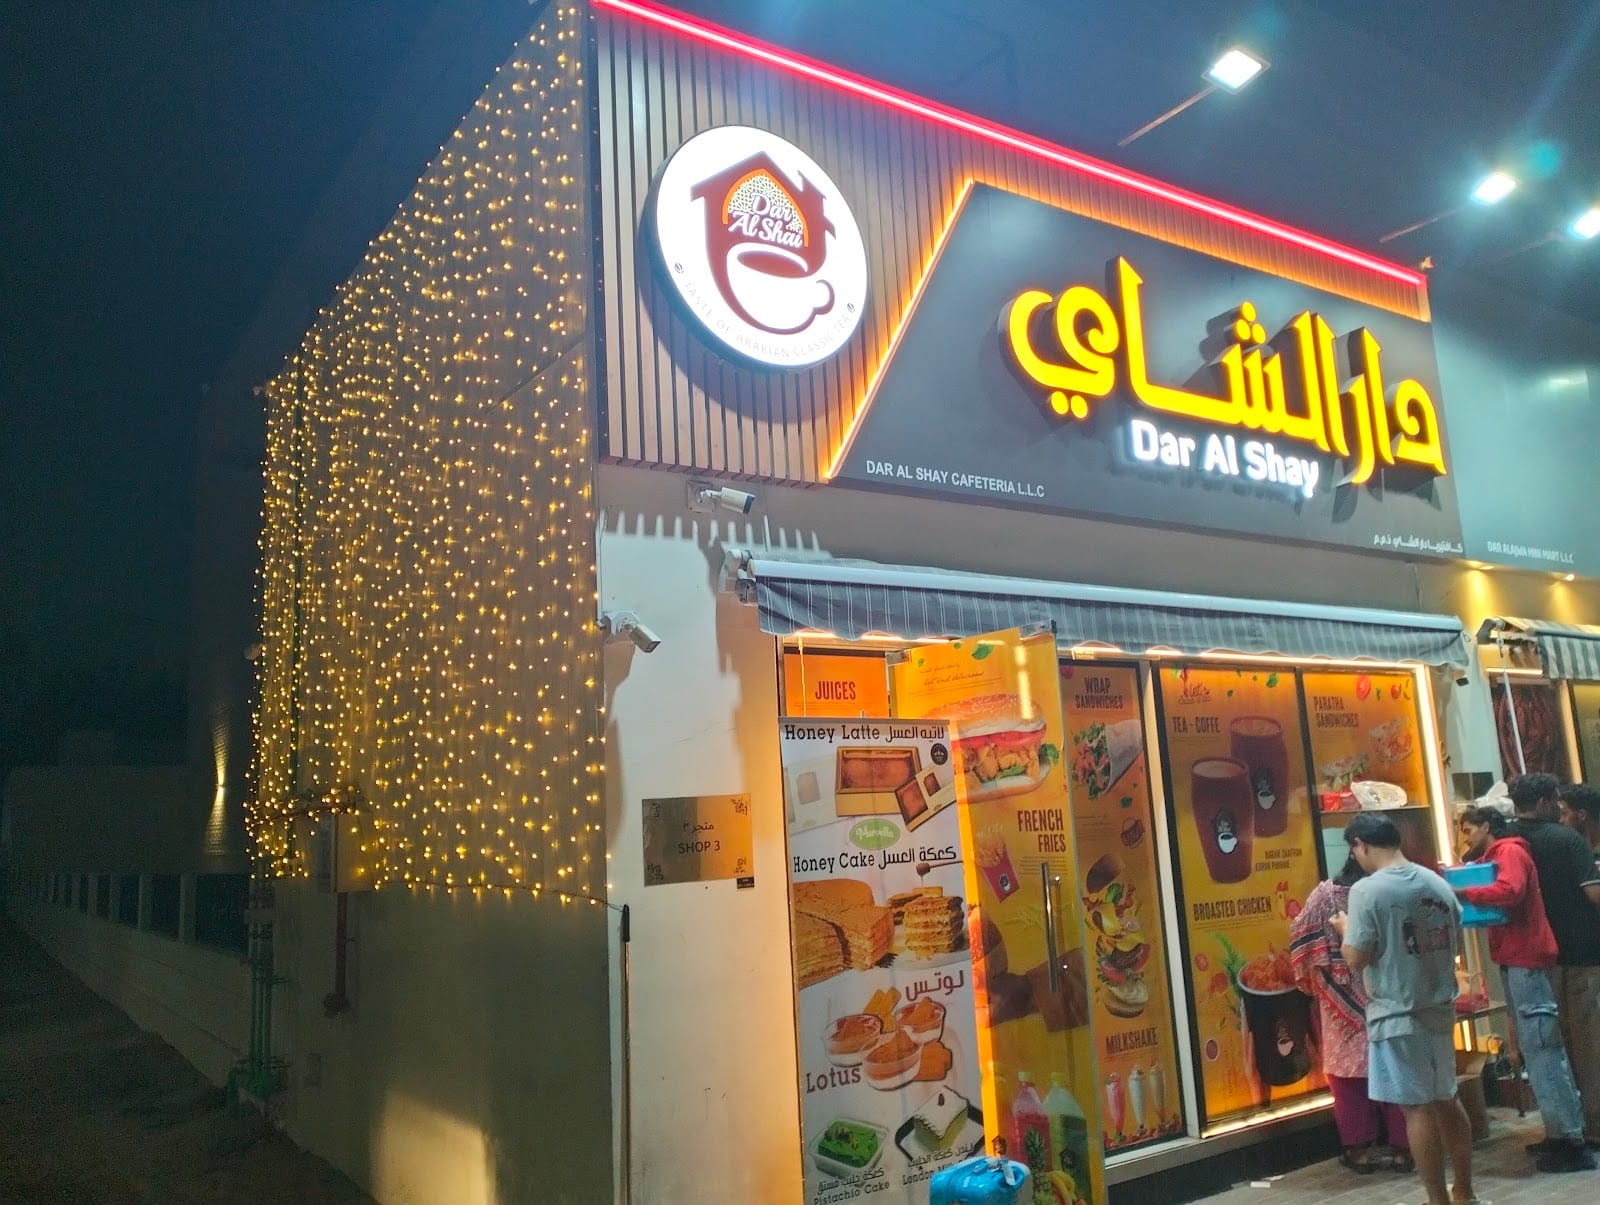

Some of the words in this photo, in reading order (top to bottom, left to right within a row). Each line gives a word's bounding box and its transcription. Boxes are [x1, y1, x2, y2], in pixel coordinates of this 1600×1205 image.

[751, 192, 793, 222] Dar
[727, 210, 760, 237] Al
[1009, 256, 1350, 457] الشاي
[1349, 326, 1447, 484] دار
[1131, 419, 1196, 467] Dar
[1204, 433, 1240, 476] Al
[1243, 441, 1319, 499] Shay
[866, 460, 894, 477] DAR
[896, 465, 913, 479] AL
[915, 467, 949, 484] SHAY
[951, 472, 1016, 494] CAFETERIA
[1018, 482, 1045, 498] L.L.C
[815, 680, 856, 700] JUICES
[1084, 676, 1111, 694] WRAP
[1075, 694, 1123, 709] SANDWICHES
[1172, 716, 1188, 734] TEA
[1316, 712, 1359, 728] SANDWICHES
[784, 724, 835, 744] Honey
[841, 725, 880, 740] Latte
[885, 725, 918, 743] العسل
[920, 726, 945, 743] لاتيه
[692, 821, 714, 834] متجر
[1017, 808, 1064, 832] FRENCH
[678, 841, 711, 854] SHOP
[713, 840, 721, 852] 3
[919, 846, 957, 862] كعكة
[1038, 834, 1066, 853] FRIES
[793, 855, 835, 874] Honey
[839, 852, 875, 869] Cake
[878, 848, 915, 871] العسل
[1193, 900, 1236, 921] BROASTED
[1237, 896, 1272, 915] CHICKEN
[905, 969, 965, 1001] لوتس
[1105, 1027, 1159, 1055] MILKSHAKE
[806, 1067, 861, 1094] Lotus
[864, 1180, 890, 1195] Cake
